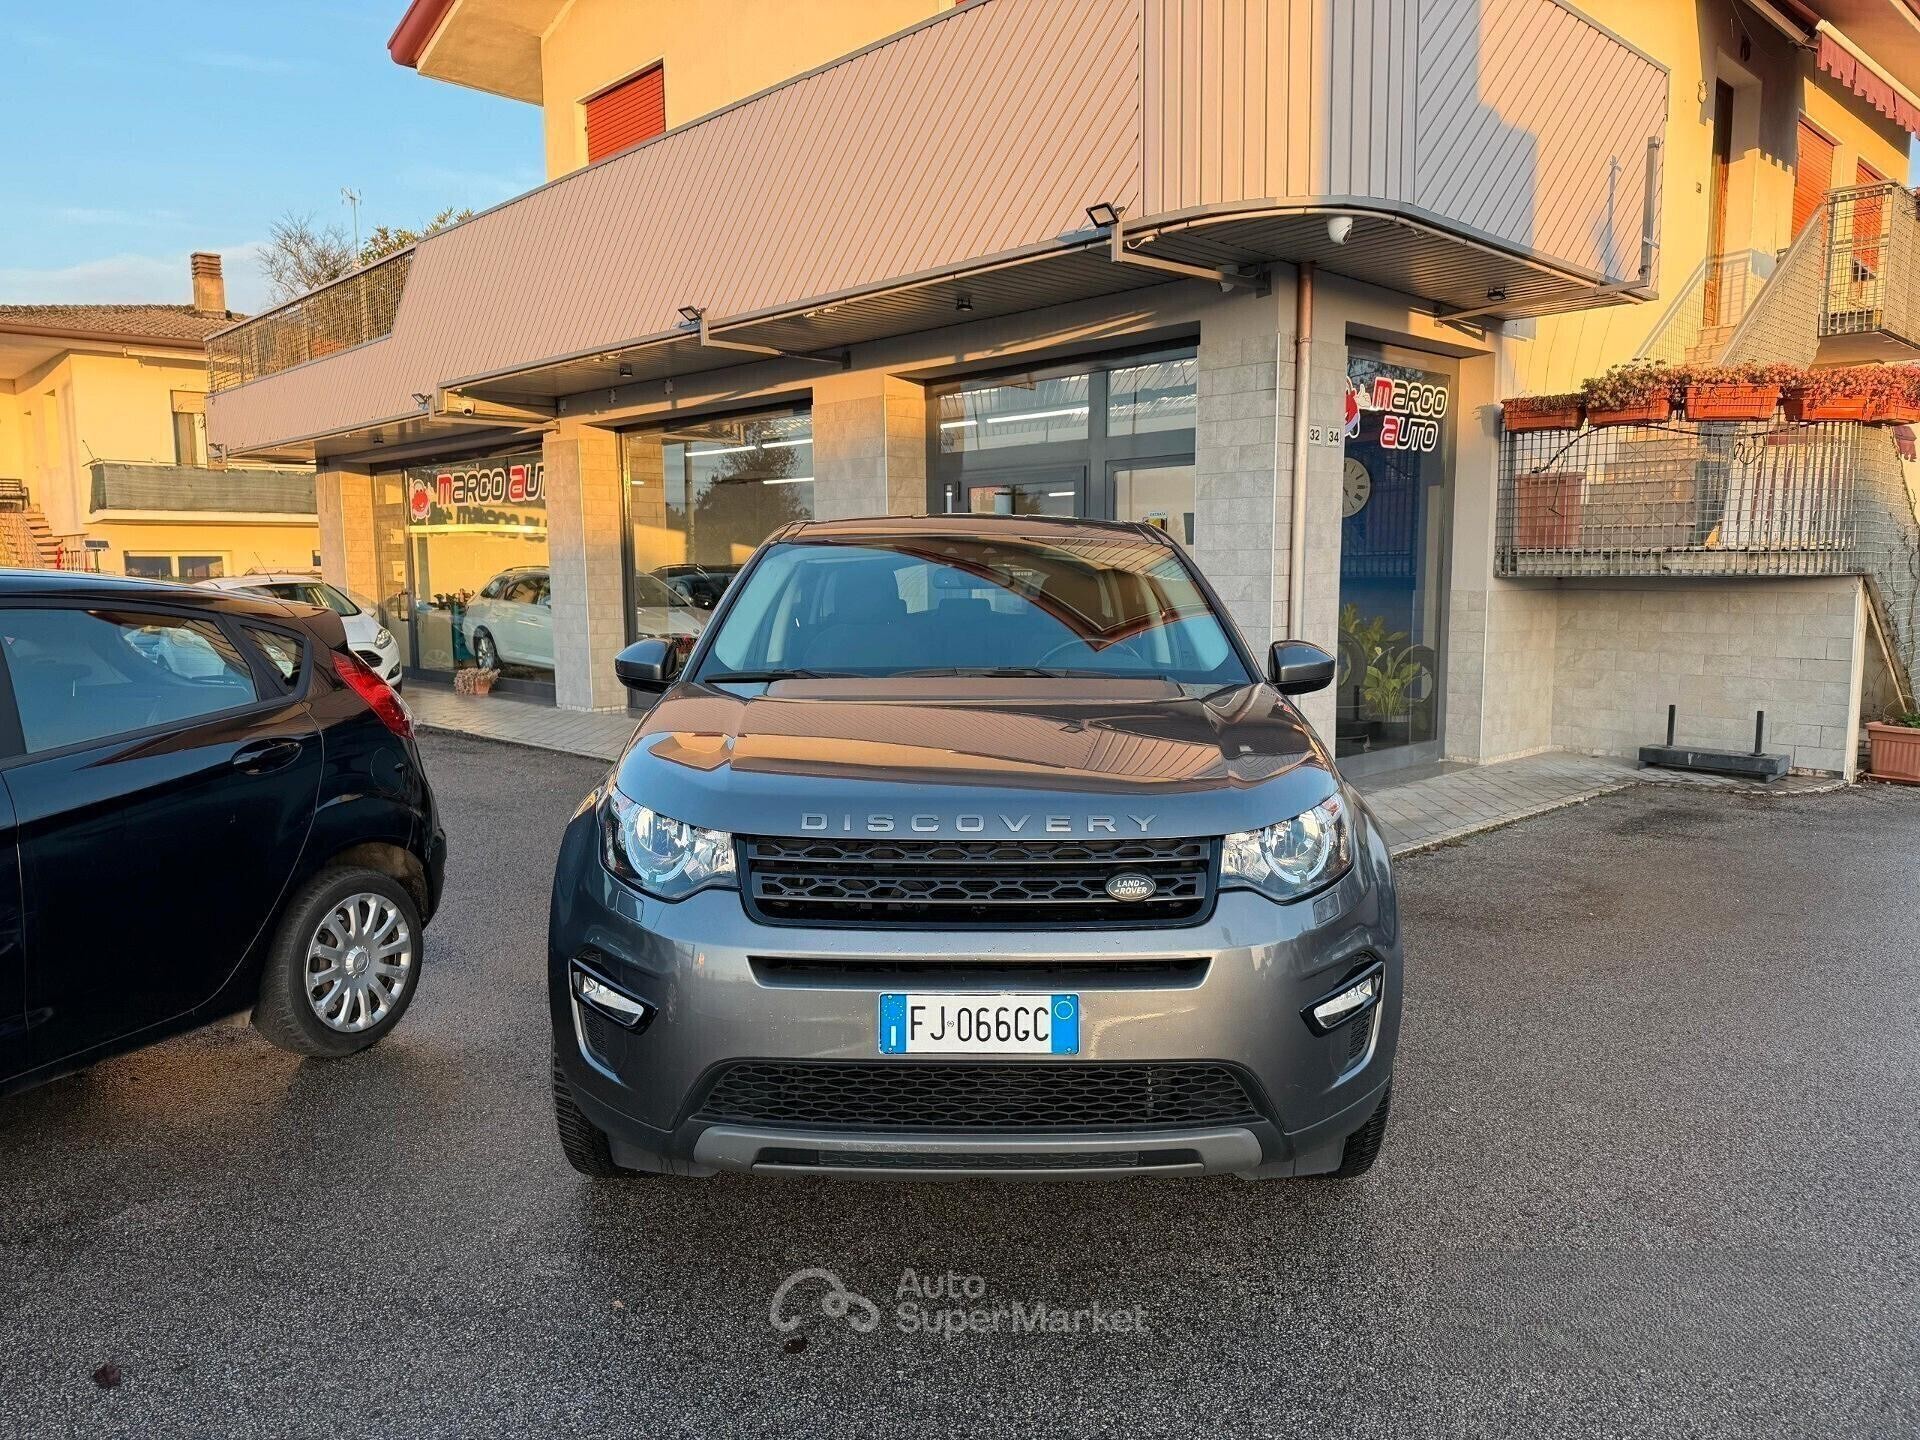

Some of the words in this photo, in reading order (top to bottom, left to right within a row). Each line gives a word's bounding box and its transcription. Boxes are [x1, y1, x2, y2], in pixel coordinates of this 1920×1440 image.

[1309, 428, 1320, 441] 32
[1328, 430, 1339, 443] 34
[801, 813, 1159, 832] DISCOVERY
[1117, 879, 1140, 887] LAND
[1119, 886, 1148, 895] ROVER
